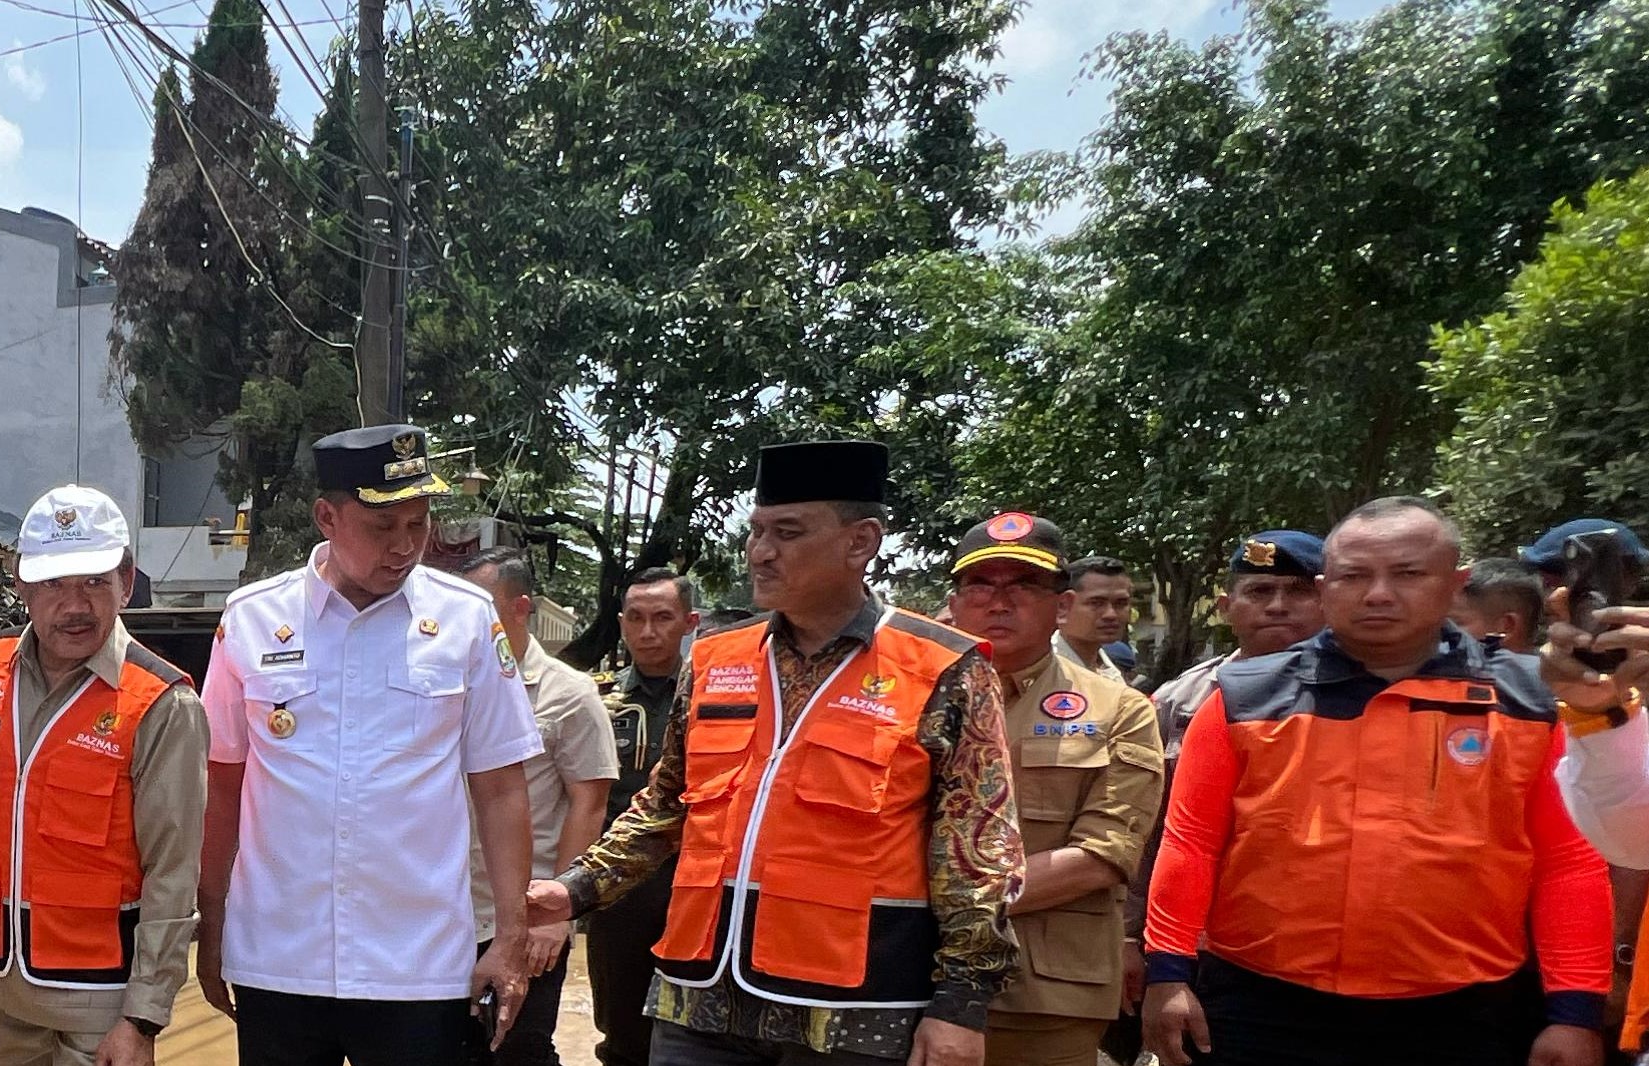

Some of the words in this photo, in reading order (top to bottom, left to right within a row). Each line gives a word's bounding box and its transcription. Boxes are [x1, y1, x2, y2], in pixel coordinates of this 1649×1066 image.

[710, 665, 754, 676] BAZNAS
[708, 675, 759, 685] TANGGAP
[705, 684, 757, 693] BENCANA
[838, 696, 897, 716] BAZNAS
[1034, 723, 1097, 736] BNPB
[75, 733, 120, 753] BAZNAS
